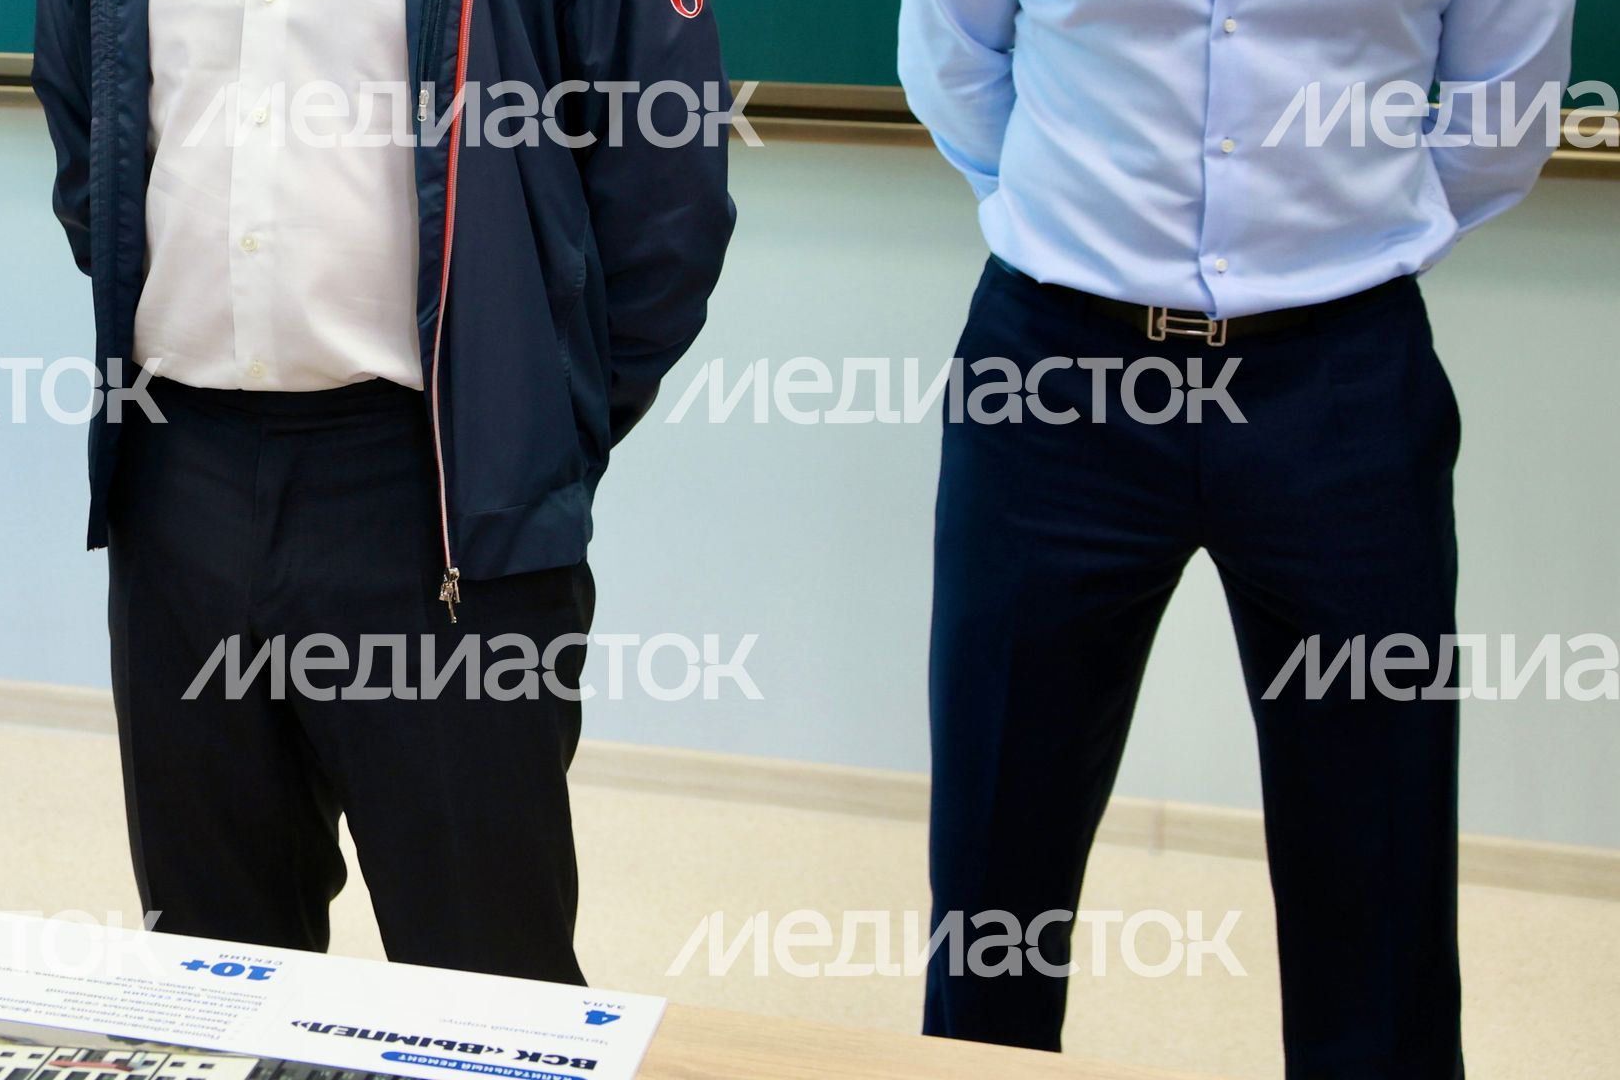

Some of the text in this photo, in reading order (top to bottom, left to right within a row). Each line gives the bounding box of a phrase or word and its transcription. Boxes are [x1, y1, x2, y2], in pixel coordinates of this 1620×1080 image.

[180, 959, 277, 981] 10+
[585, 1009, 622, 1026] 4
[291, 1020, 598, 1071] ВСК «ВЫМПЕЛ»
[397, 1054, 457, 1070] РЕМОНТ
